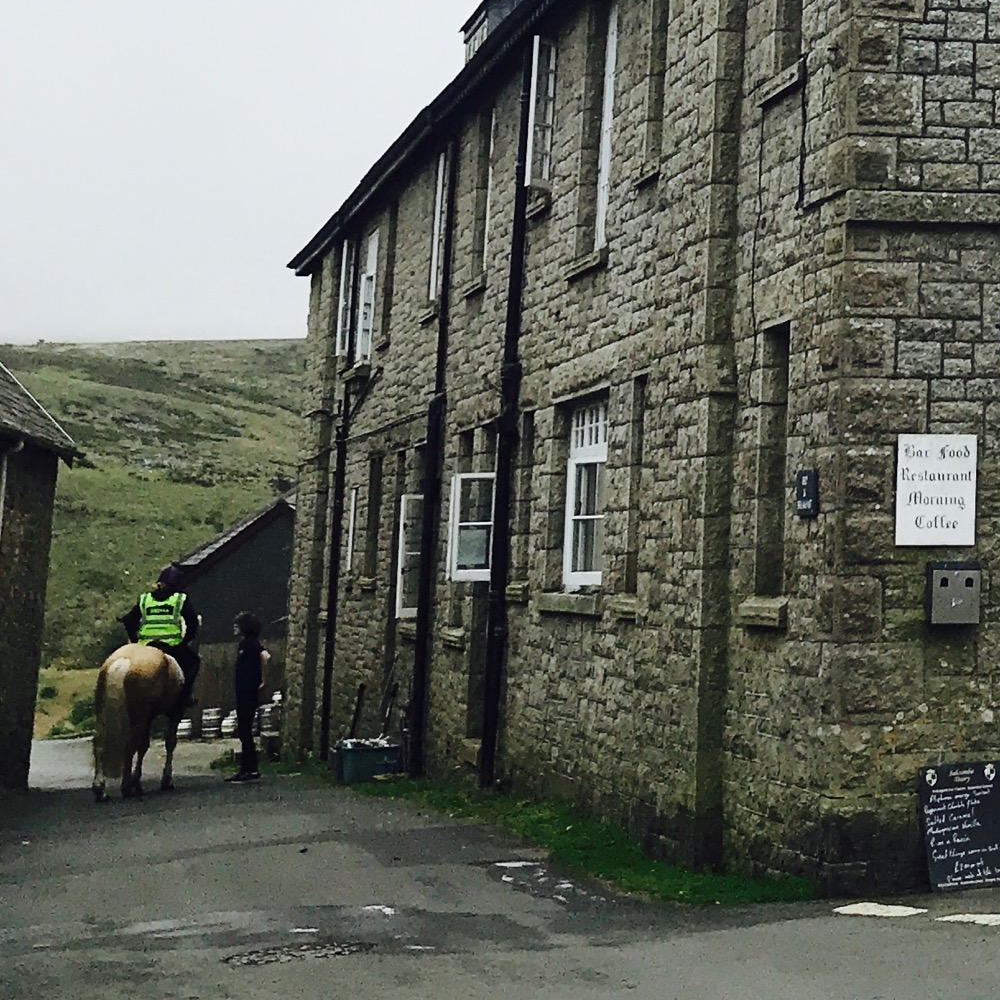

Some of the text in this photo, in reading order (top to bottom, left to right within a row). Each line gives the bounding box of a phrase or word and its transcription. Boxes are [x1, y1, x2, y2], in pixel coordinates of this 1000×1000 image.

[904, 444, 971, 460] Bar Food
[900, 467, 972, 482] Restaurant
[906, 491, 966, 510] Morning
[914, 515, 959, 529] Coffee
